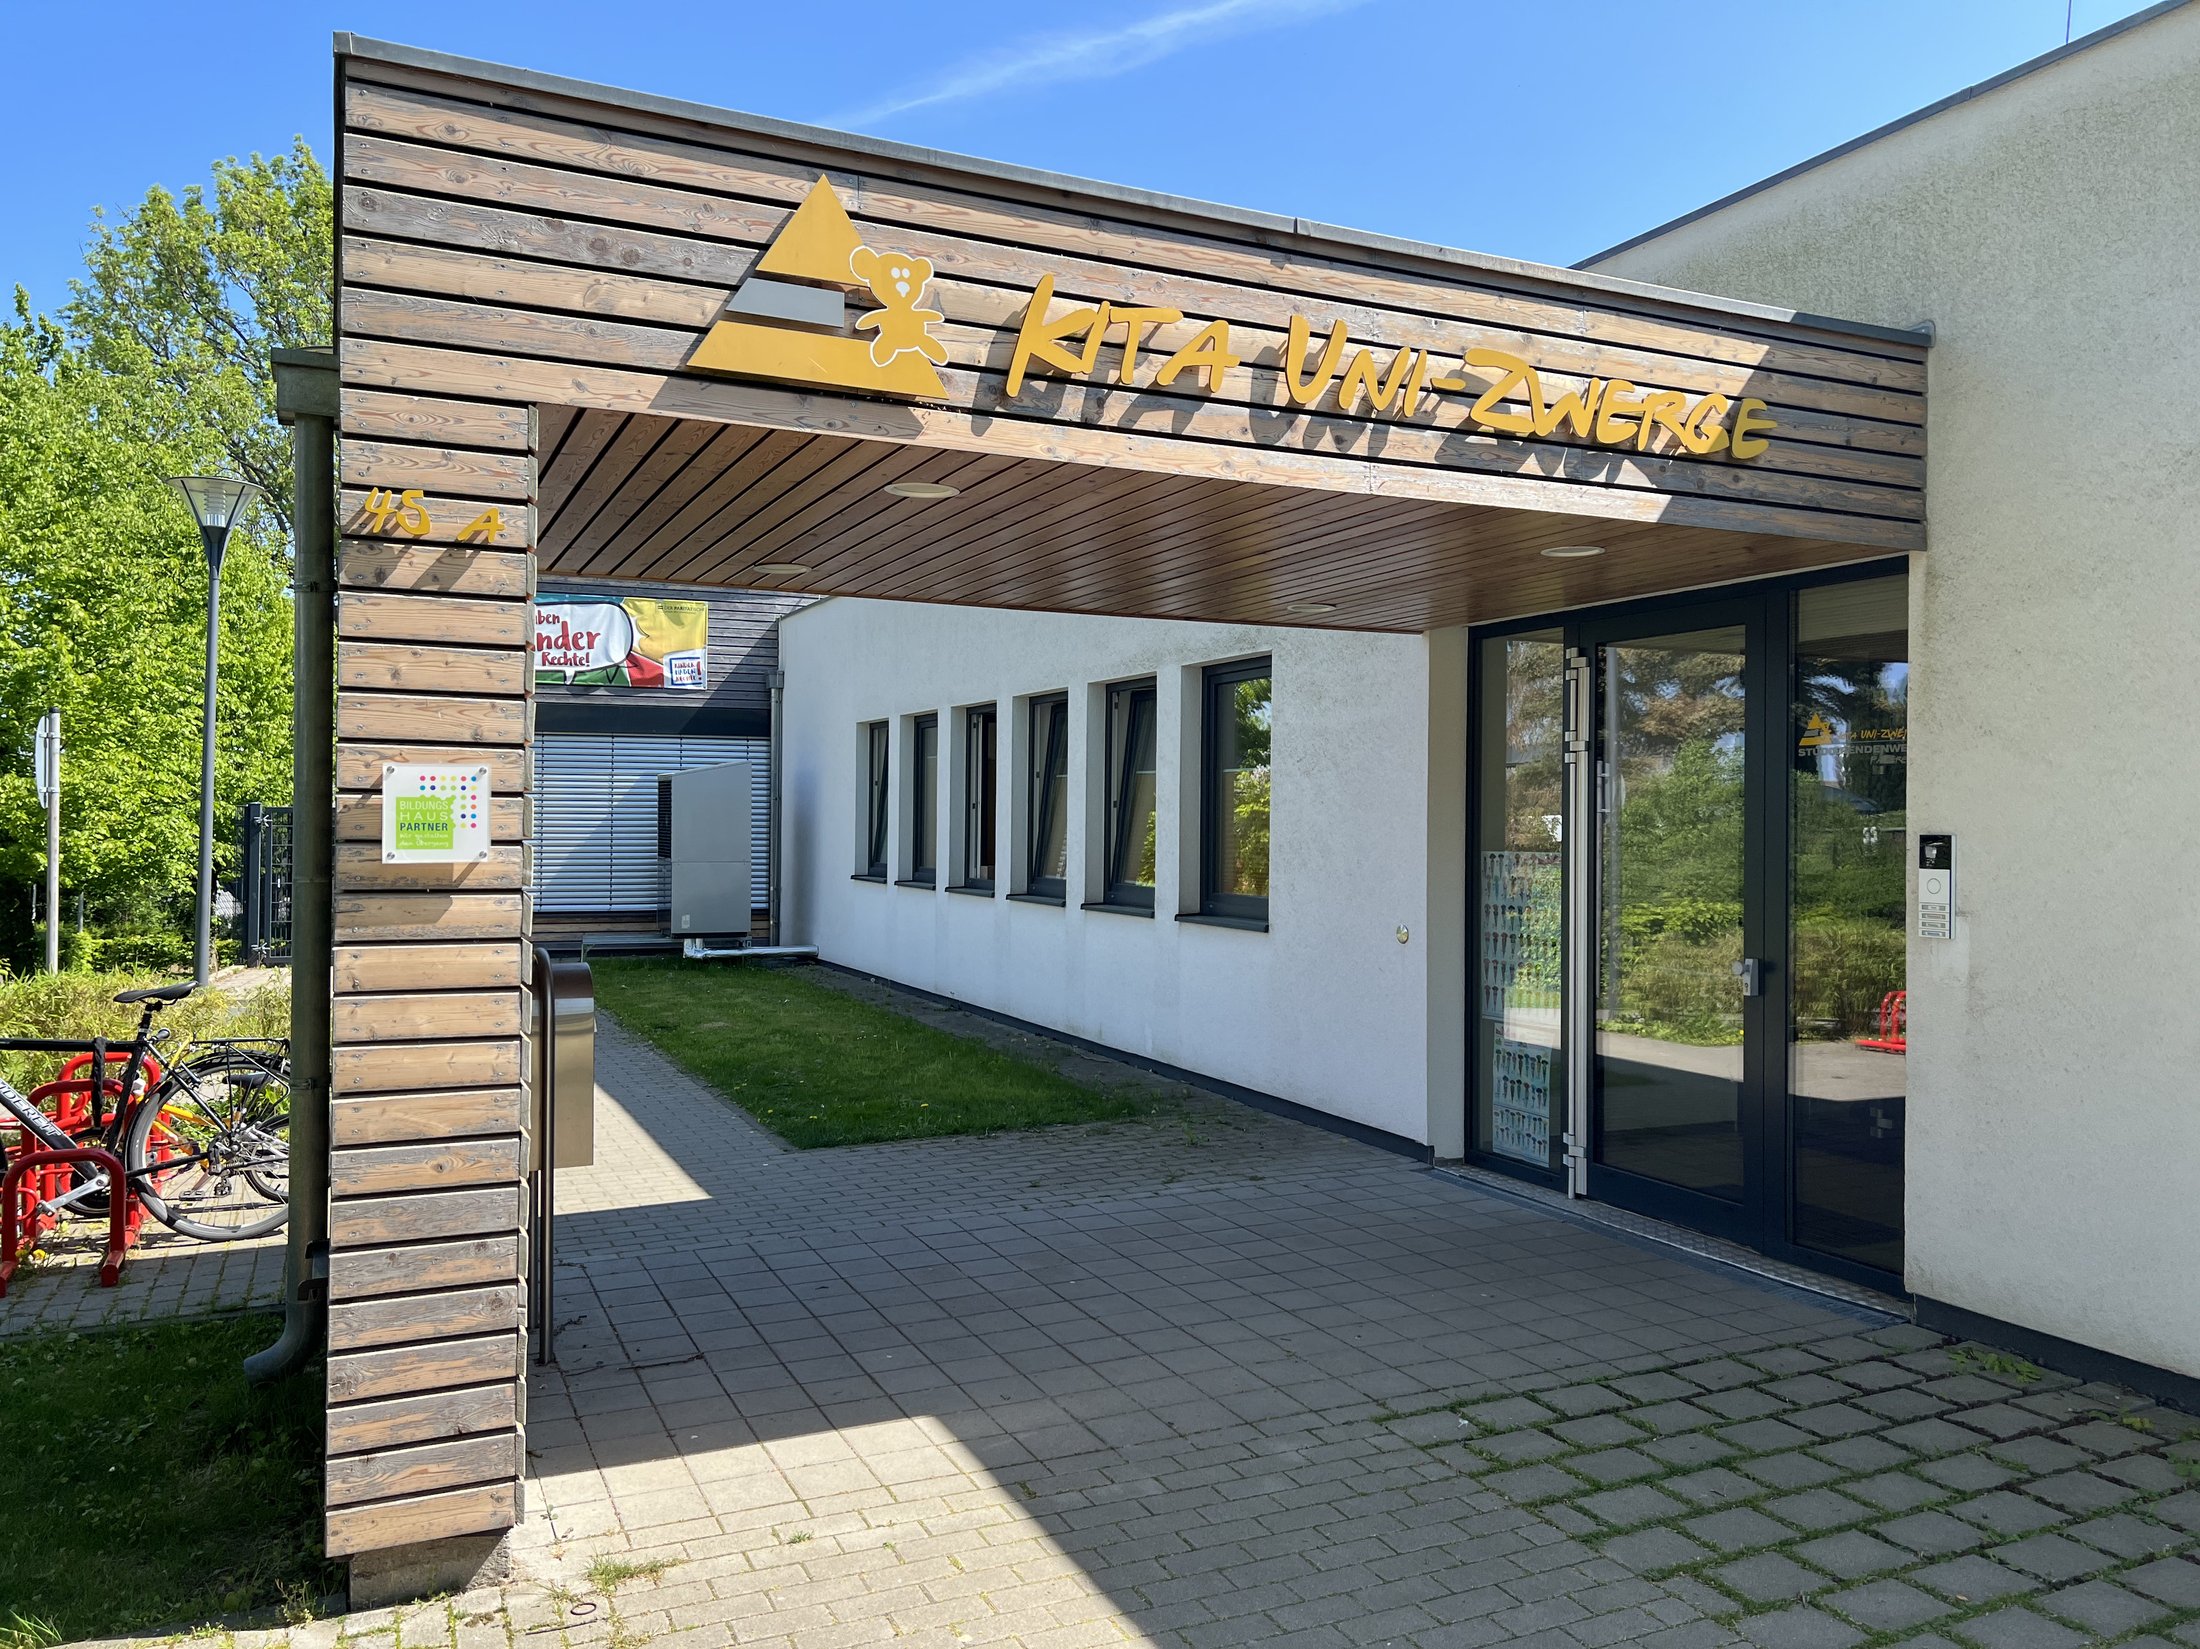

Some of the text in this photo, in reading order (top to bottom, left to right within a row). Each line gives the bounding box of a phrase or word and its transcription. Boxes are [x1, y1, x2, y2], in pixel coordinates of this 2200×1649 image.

[1005, 273, 1778, 460] KITA UNI-ZWERGE
[365, 487, 506, 543] 45 A
[535, 609, 560, 625] ben
[533, 620, 601, 652] nder
[541, 651, 590, 667] Rechte!
[399, 801, 449, 810] BILDUNGS
[399, 811, 449, 821] HAUS
[399, 822, 449, 832] PARTNER
